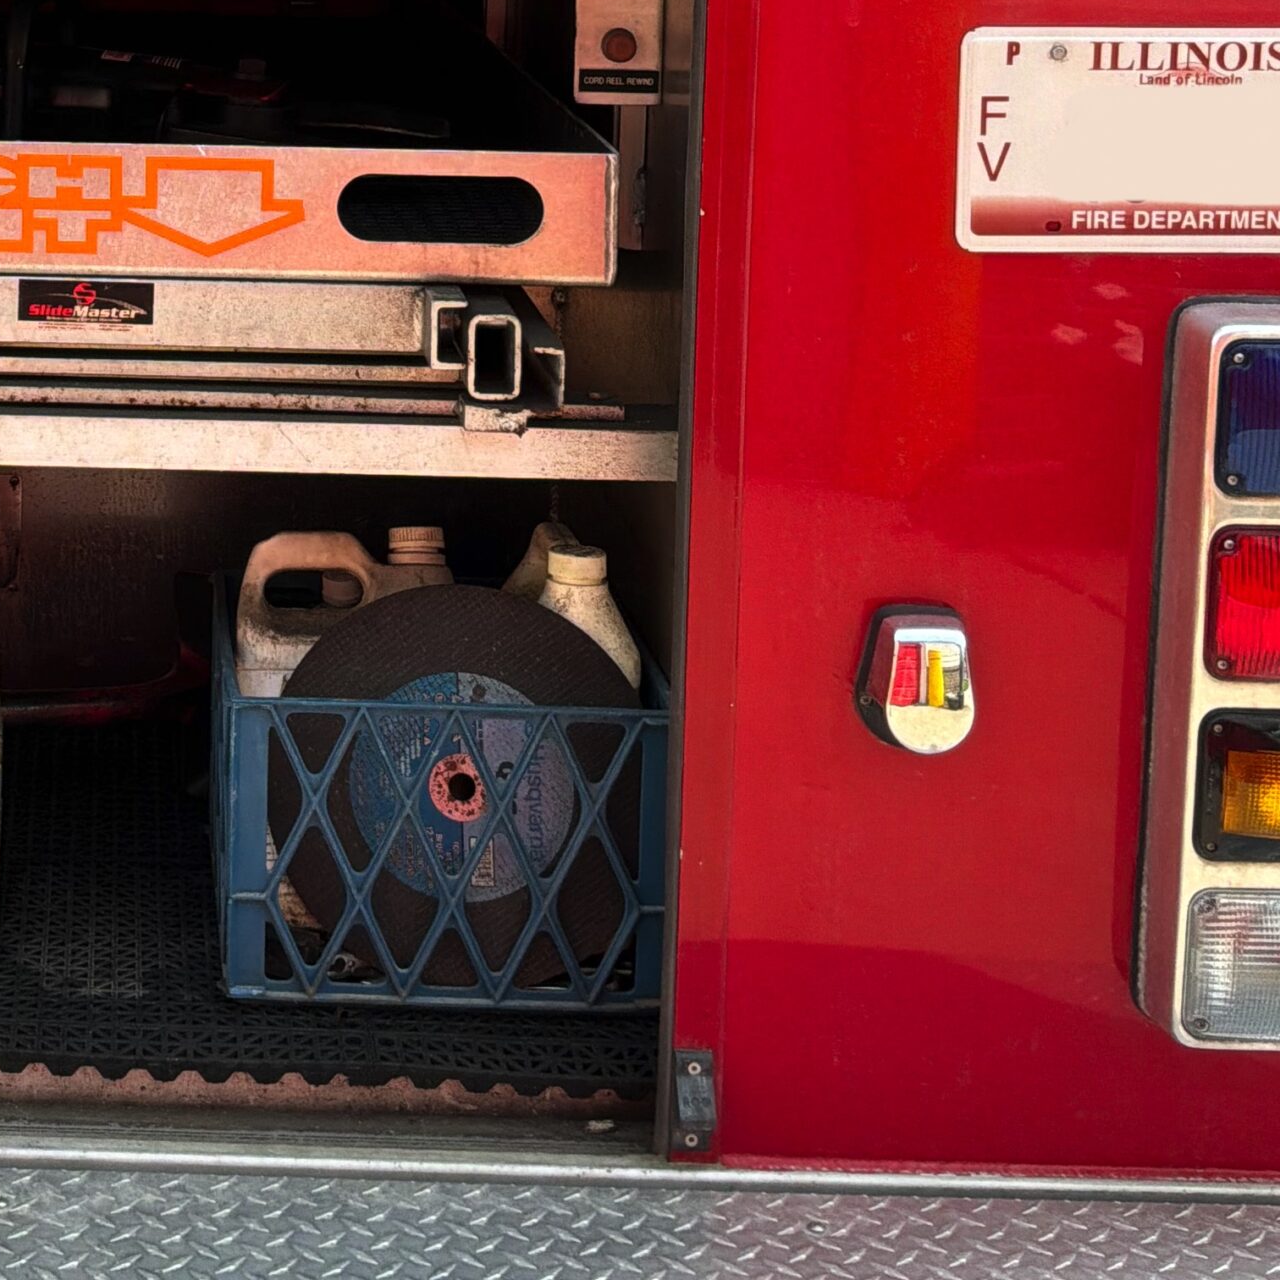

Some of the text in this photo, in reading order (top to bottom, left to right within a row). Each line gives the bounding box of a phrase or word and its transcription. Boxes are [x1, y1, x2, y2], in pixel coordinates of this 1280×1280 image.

[1006, 41, 1020, 66] P
[583, 76, 655, 86] CORD REEL REWIND
[1139, 73, 1243, 86] Land of Lincoln
[980, 96, 1010, 136] F
[976, 141, 1012, 182] V
[1071, 209, 1280, 230] FIRE DEPARTMEN
[28, 303, 139, 319] SlideMaster
